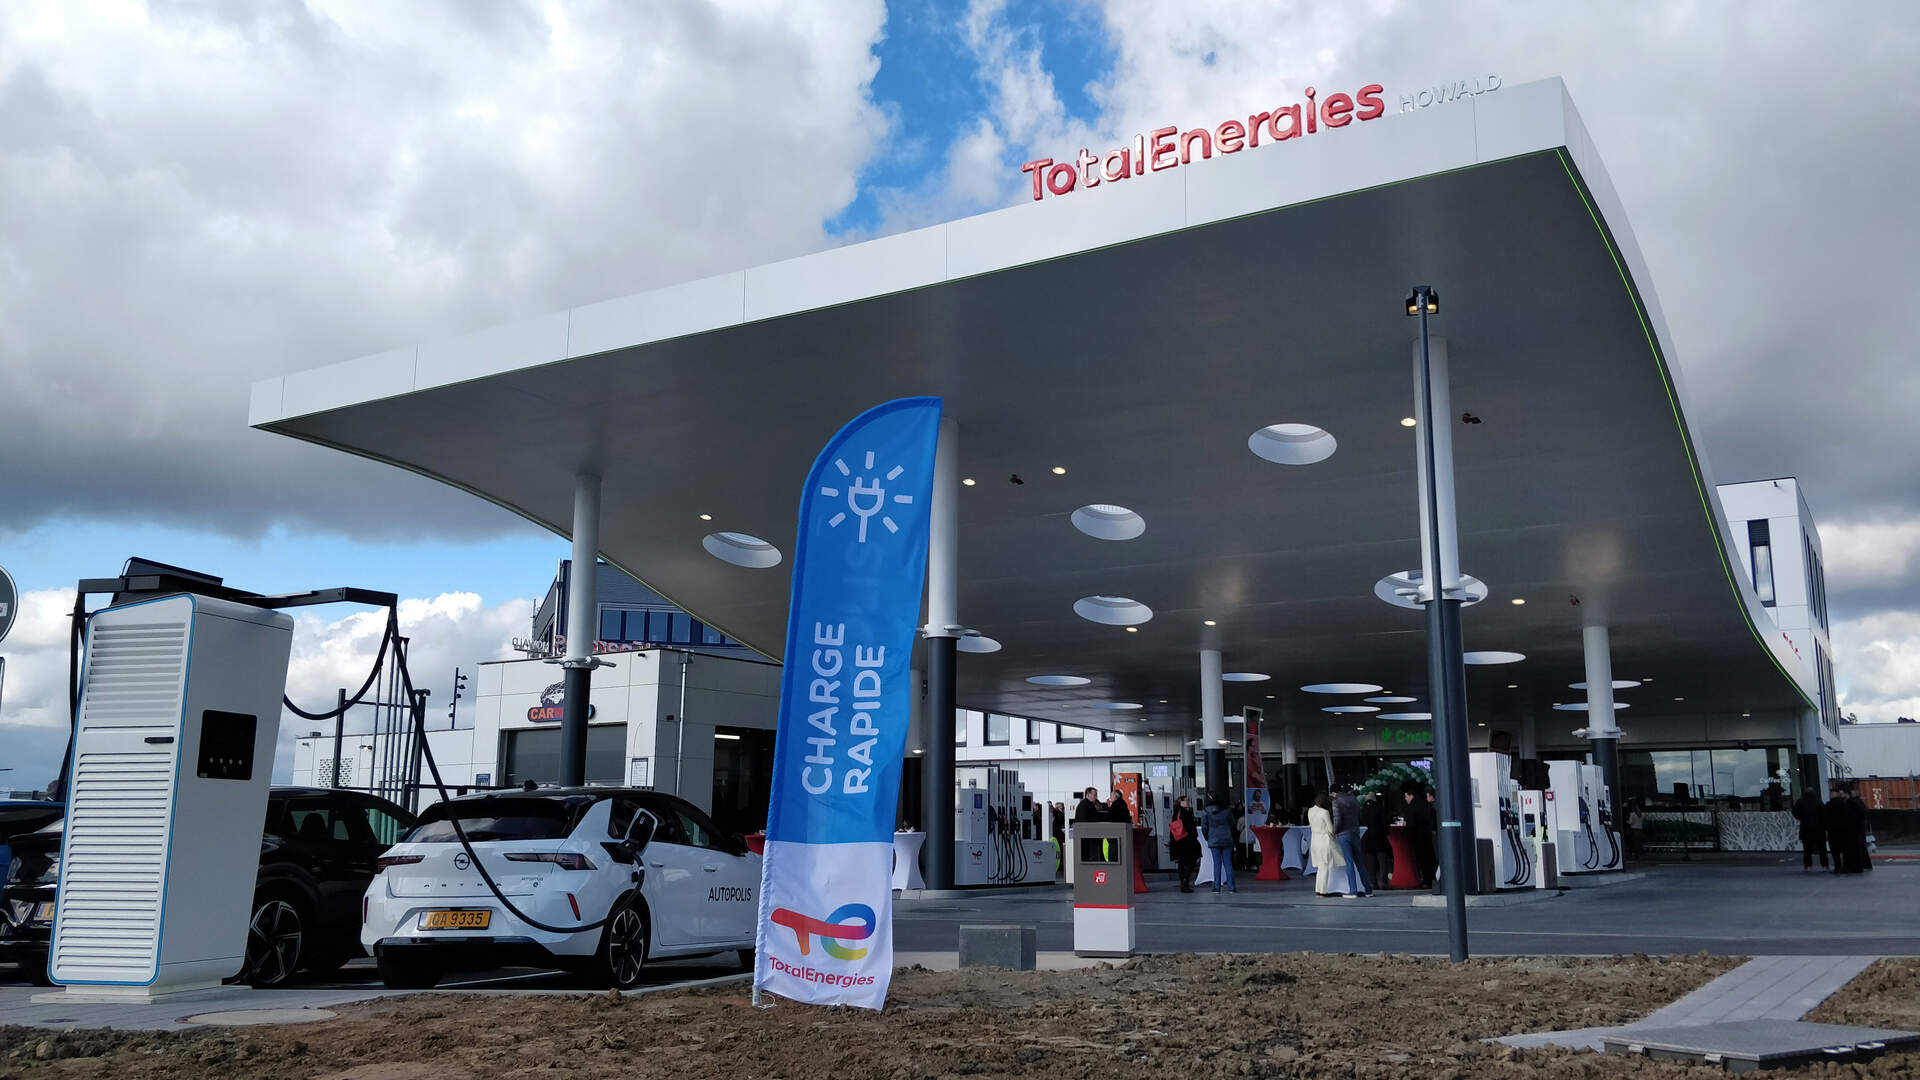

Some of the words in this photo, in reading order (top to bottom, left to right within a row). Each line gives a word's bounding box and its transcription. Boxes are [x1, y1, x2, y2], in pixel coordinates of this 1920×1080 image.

[1399, 75, 1503, 113] HOWALD
[802, 621, 845, 794] CHARGE
[843, 645, 885, 794] RAPIDE
[708, 887, 752, 902] AUTOPOLIS
[450, 912, 484, 925] 9335
[769, 957, 876, 988] TotalEnergies
